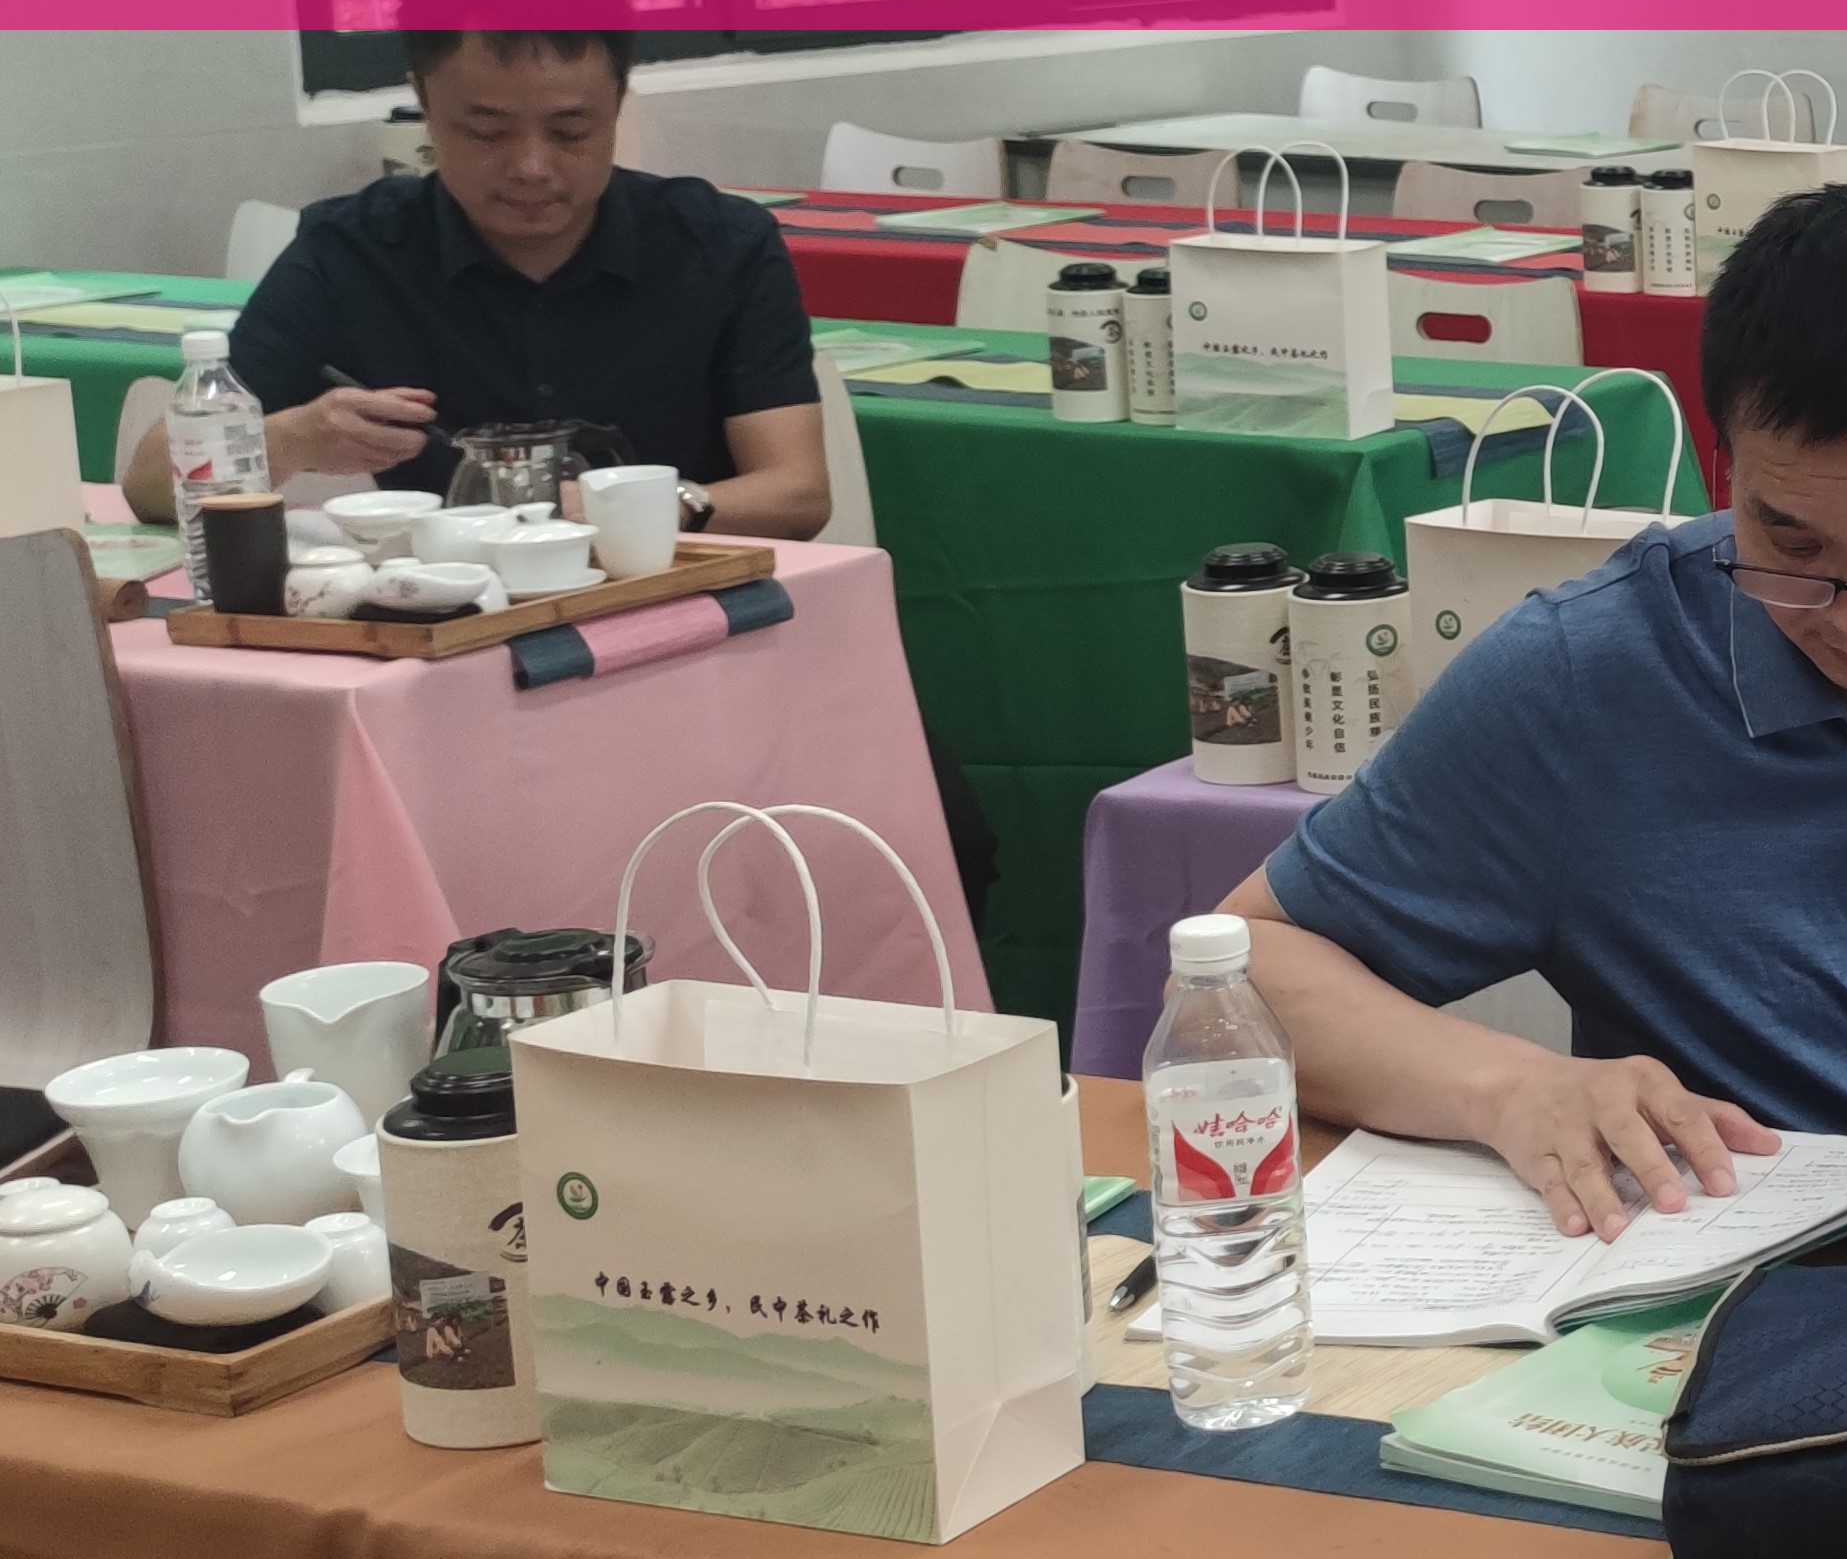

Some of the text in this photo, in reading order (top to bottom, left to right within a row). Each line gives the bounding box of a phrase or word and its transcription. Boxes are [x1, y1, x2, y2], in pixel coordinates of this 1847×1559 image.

[1193, 1106, 1283, 1137] 娃哈哈
[595, 1271, 879, 1333] 中国玉露之乡，民中茶礼之作
